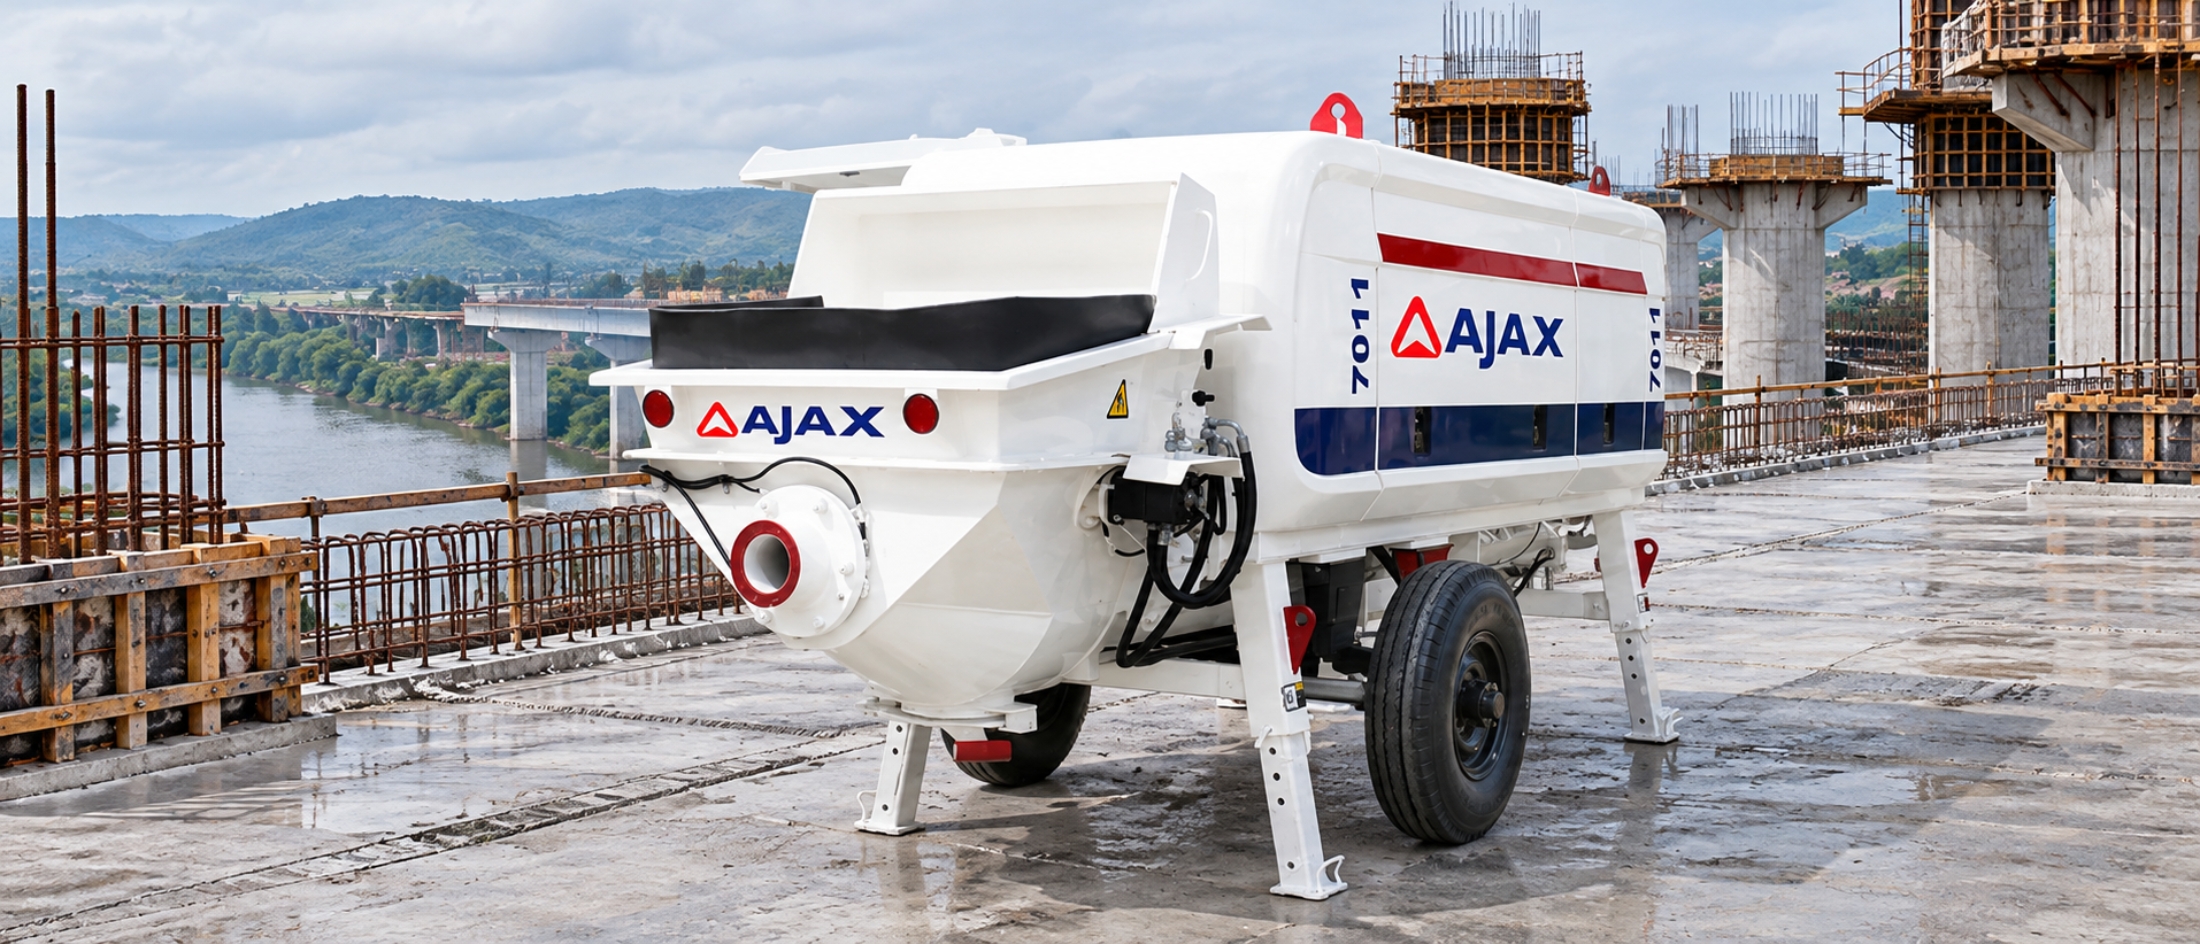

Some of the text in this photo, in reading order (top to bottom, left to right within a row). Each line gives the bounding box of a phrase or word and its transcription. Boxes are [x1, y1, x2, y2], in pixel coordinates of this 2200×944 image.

[1351, 279, 1369, 394] 7011
[1445, 308, 1564, 370] AJAX
[1650, 308, 1661, 392] 7011
[742, 405, 884, 445] AJAX
